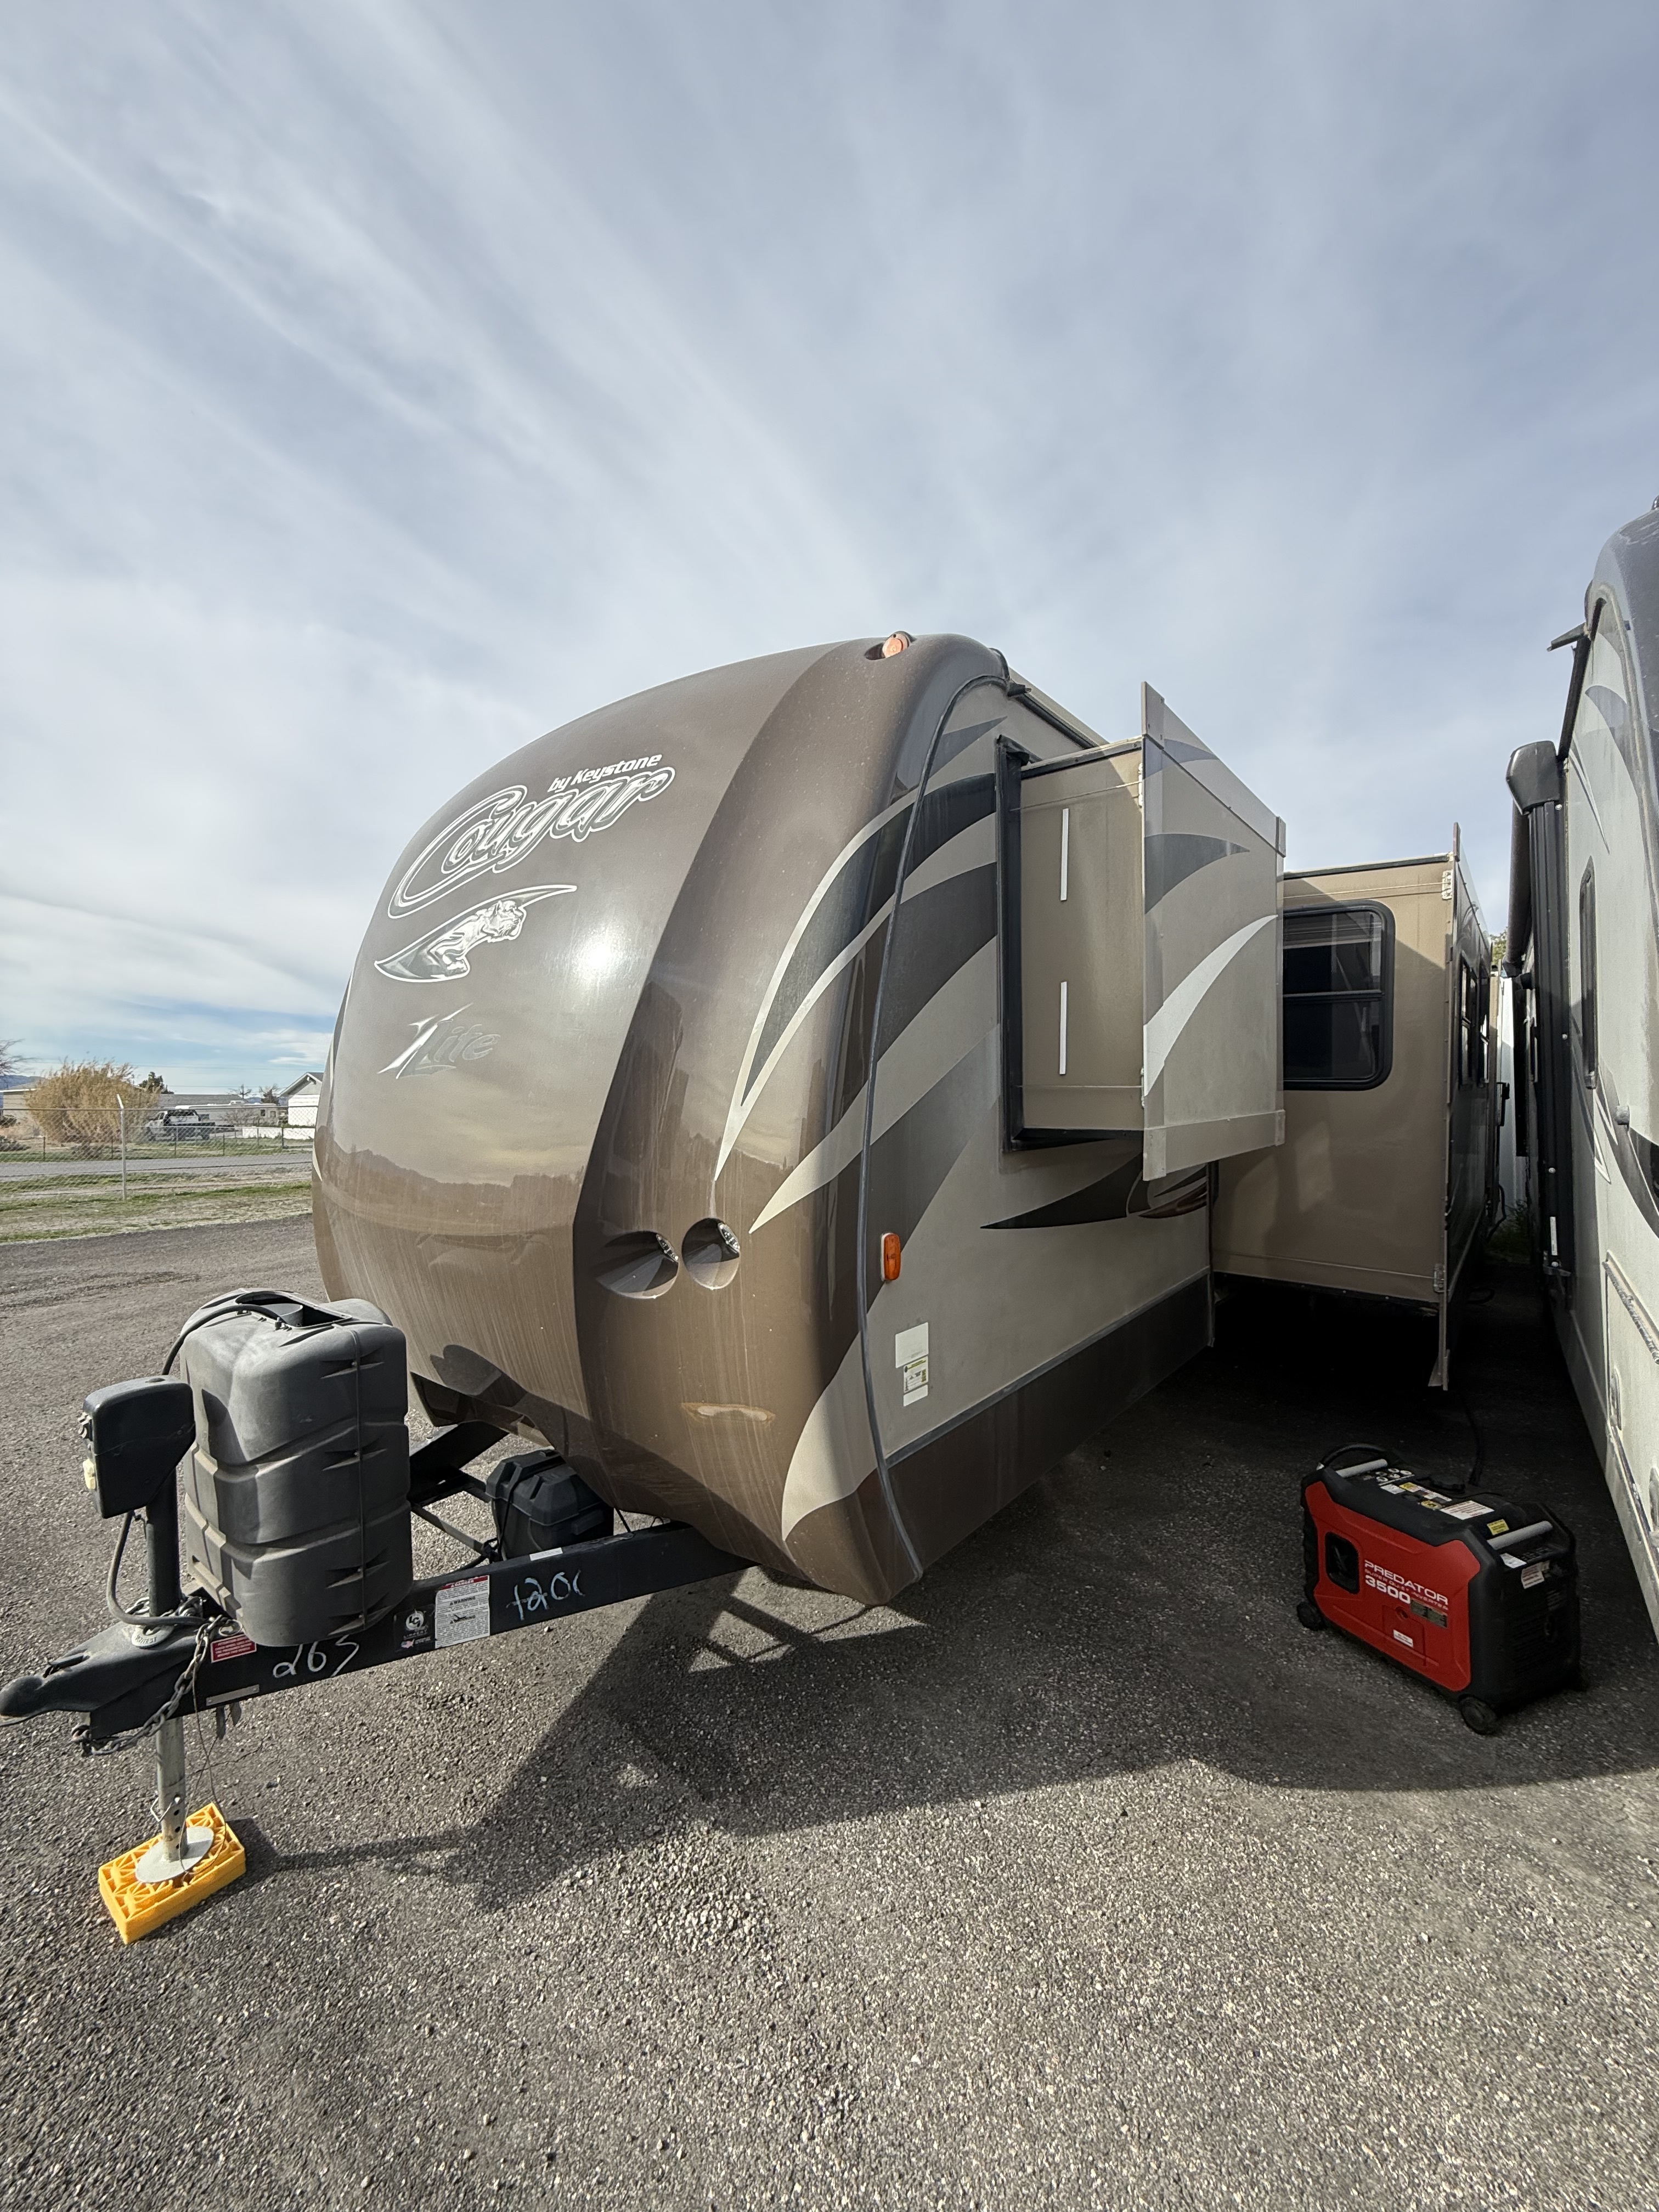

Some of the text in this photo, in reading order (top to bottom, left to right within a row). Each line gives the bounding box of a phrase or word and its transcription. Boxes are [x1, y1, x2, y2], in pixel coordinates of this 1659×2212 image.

[548, 754, 663, 793] by Keystone
[388, 767, 675, 919] Cougar
[1364, 1568, 1389, 1583] SUPER
[1364, 1560, 1448, 1605] PREDATOR
[1365, 1575, 1411, 1604] 3500
